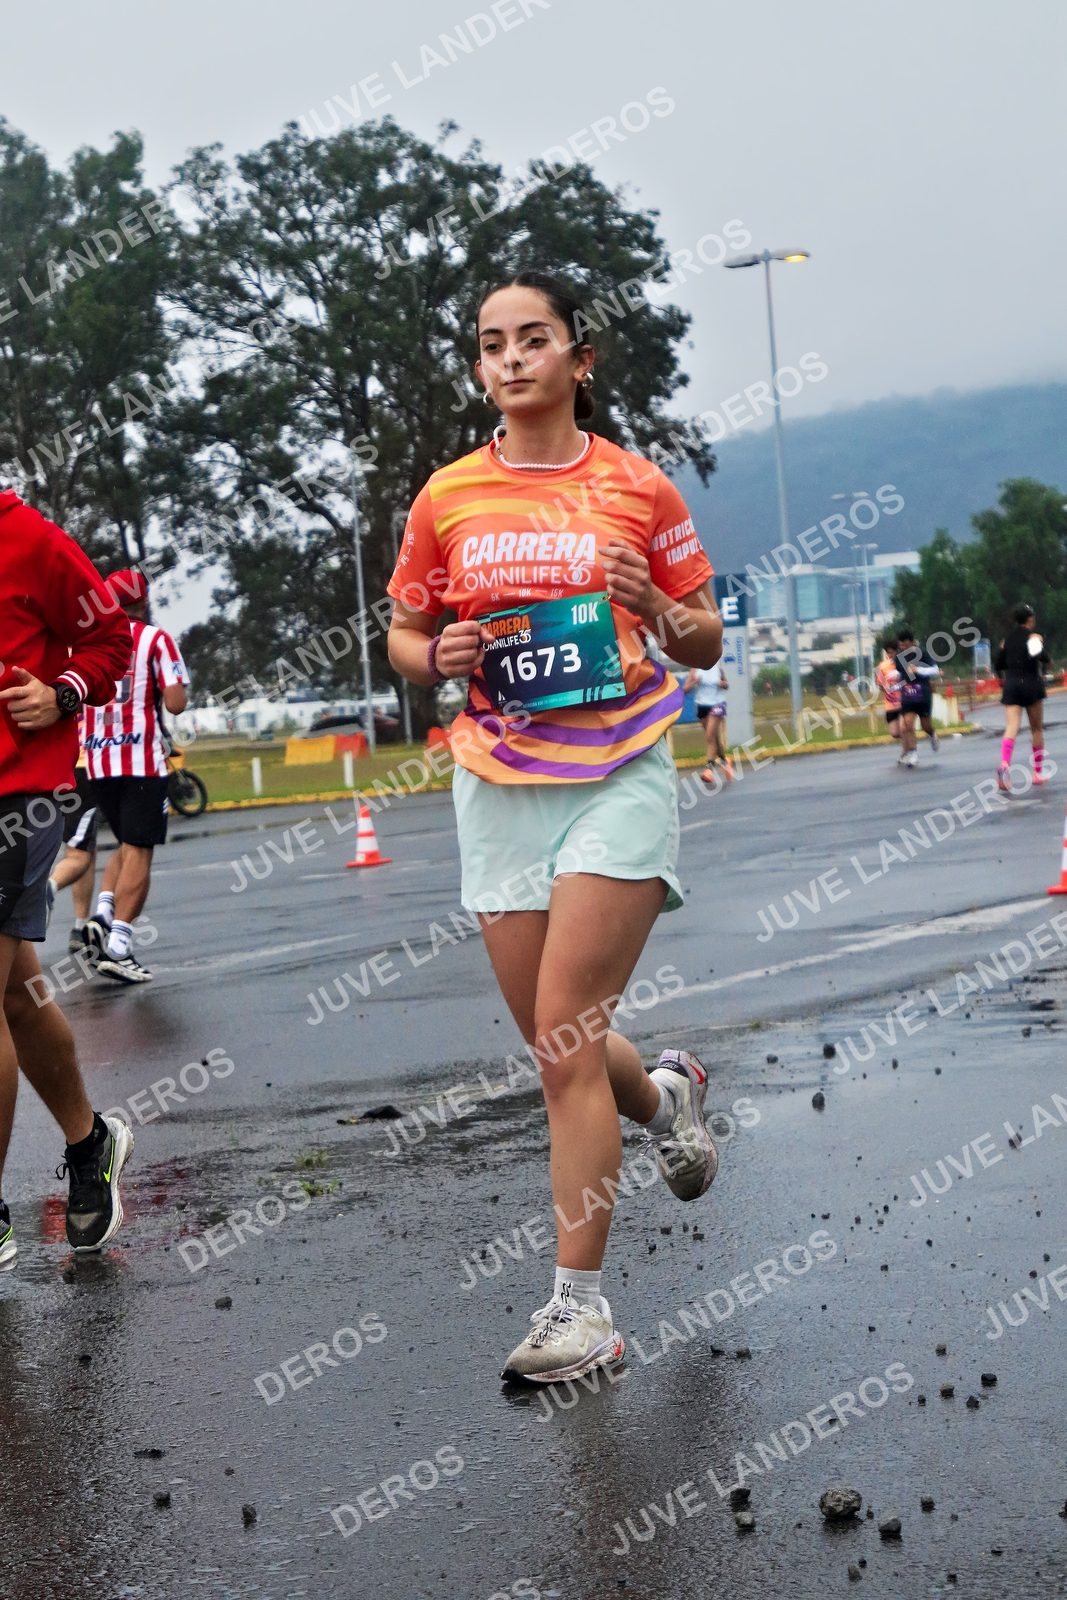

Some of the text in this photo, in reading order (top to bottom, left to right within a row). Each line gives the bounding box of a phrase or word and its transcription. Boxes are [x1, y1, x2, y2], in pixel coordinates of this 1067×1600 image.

[462, 531, 597, 569] CARRERA
[464, 565, 563, 592] OMNILIFE
[518, 587, 532, 598] 10K
[571, 601, 600, 625] 10K
[722, 596, 740, 621] E
[500, 642, 582, 685] 1673
